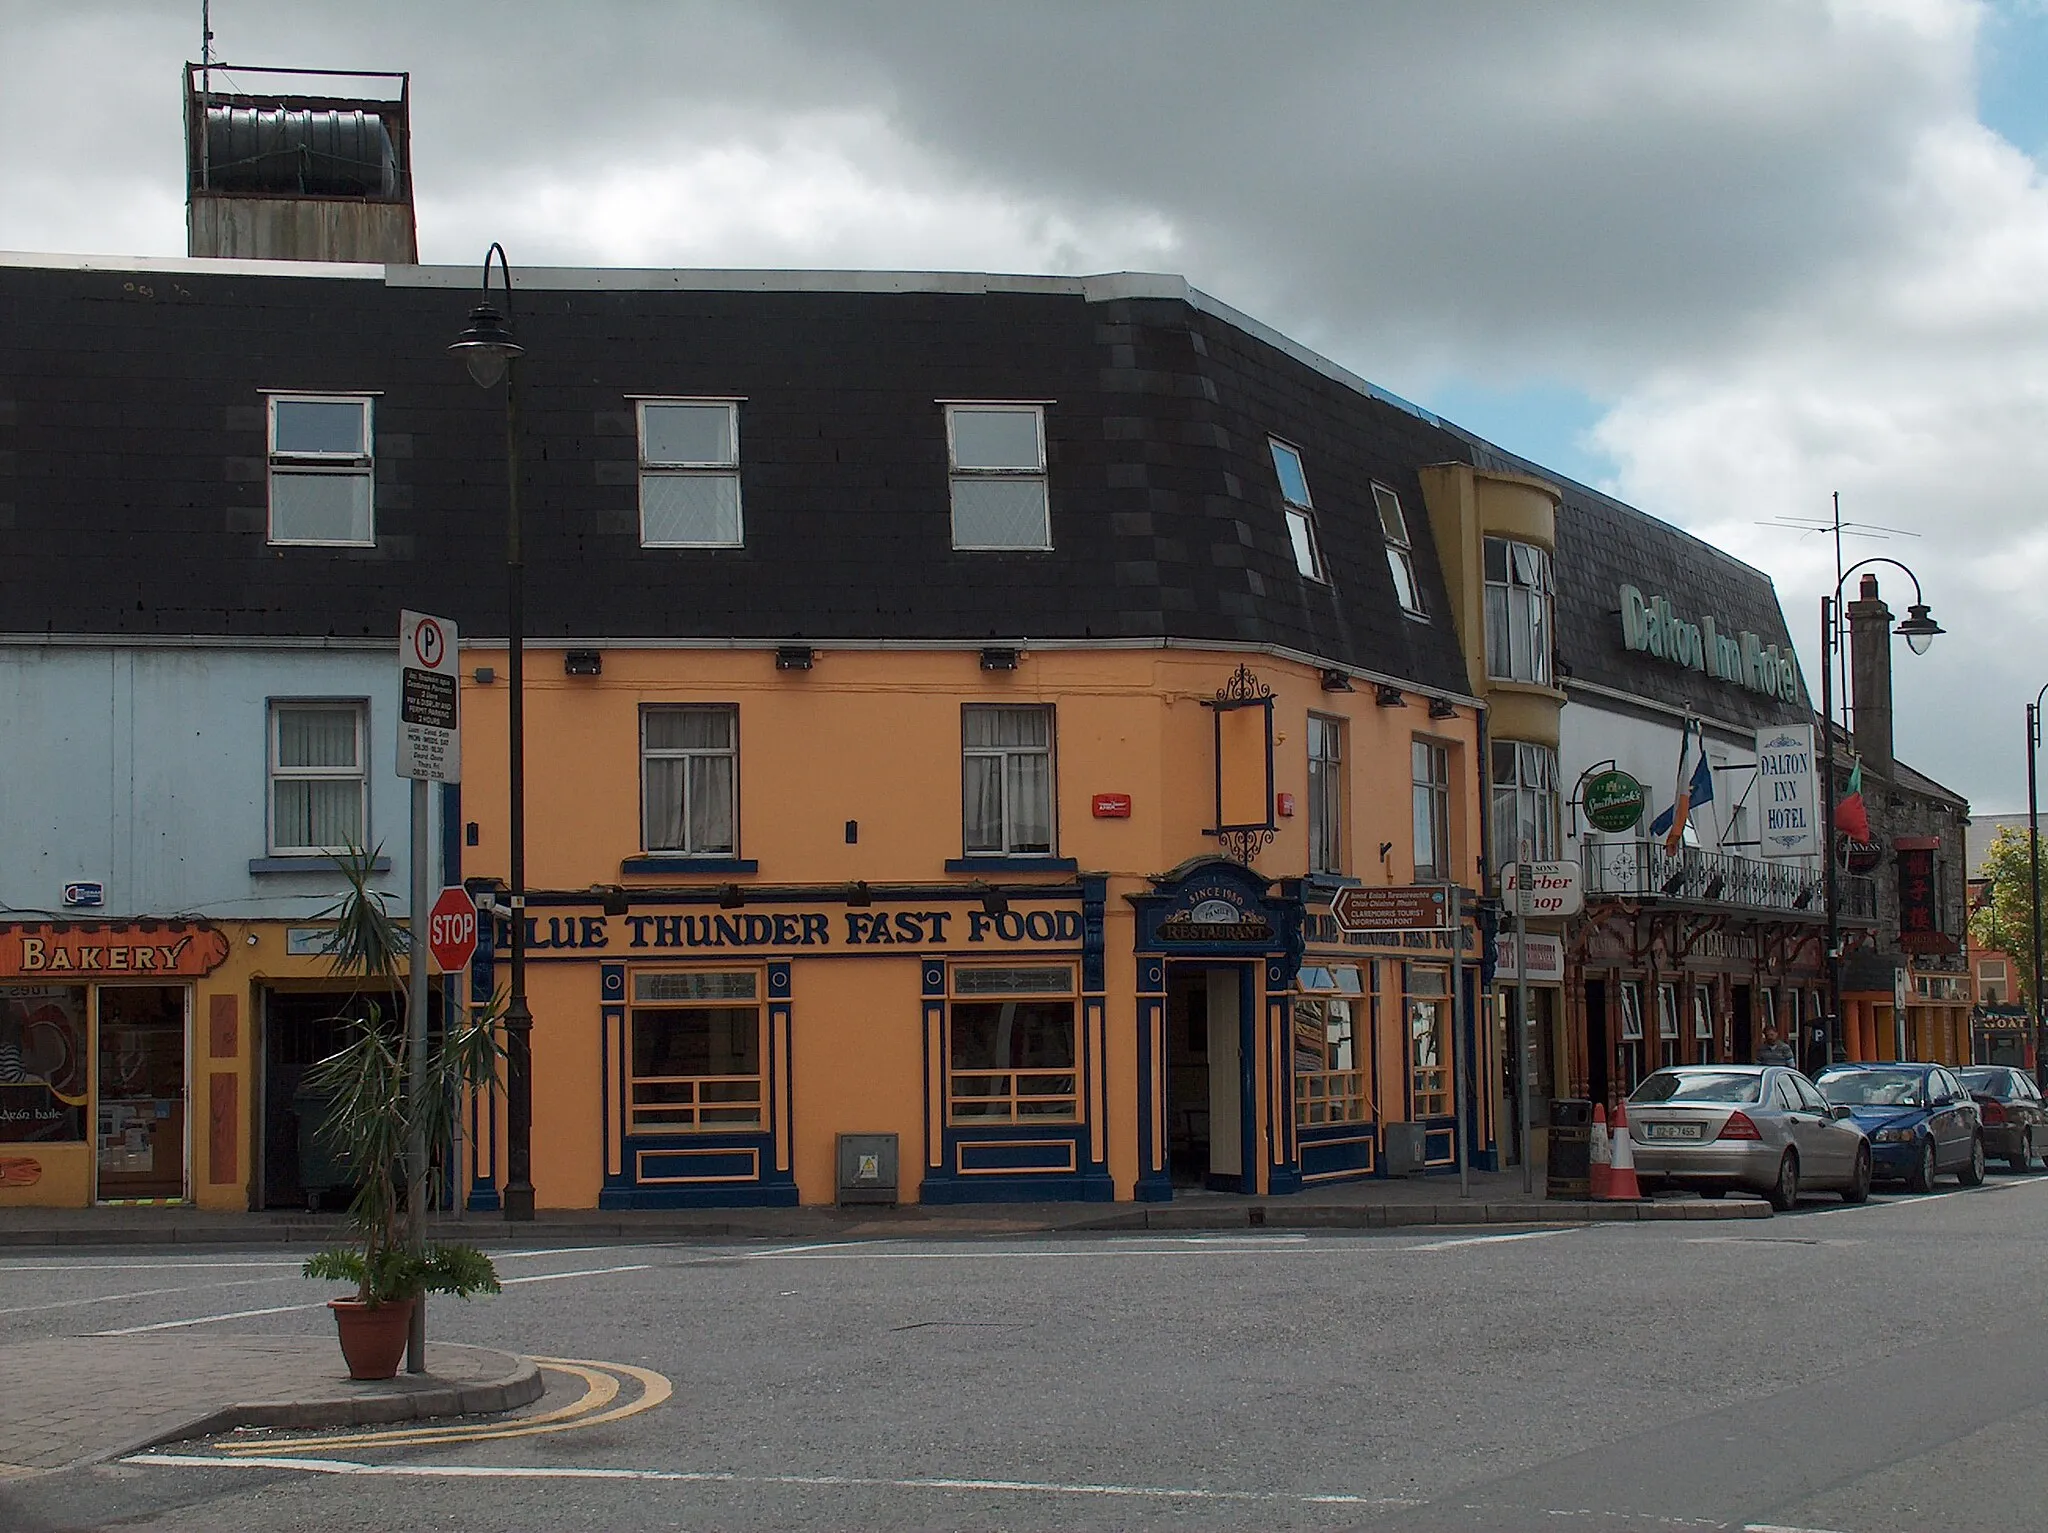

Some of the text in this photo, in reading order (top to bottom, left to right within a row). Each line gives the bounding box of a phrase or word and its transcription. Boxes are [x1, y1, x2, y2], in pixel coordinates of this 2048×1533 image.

[424, 627, 435, 658] P
[1619, 584, 1798, 703] Dalton Inn Hotel
[1760, 753, 1807, 775] DALTON
[1774, 781, 1796, 801] INN
[1768, 808, 1806, 829] HOTEL
[1506, 875, 1572, 891] Brber
[1189, 887, 1220, 904] SINCE
[1350, 909, 1424, 918] CLAREMORRIS TOURIST
[1351, 918, 1393, 926] INFORMATION
[432, 913, 473, 945] STOP
[625, 913, 830, 948] THUNDER
[845, 911, 951, 944] FAST
[968, 909, 1083, 942] FOOD
[1167, 923, 1265, 939] RESTAURANT
[20, 935, 193, 971] BAKERY
[1815, 1029, 1824, 1042] P
